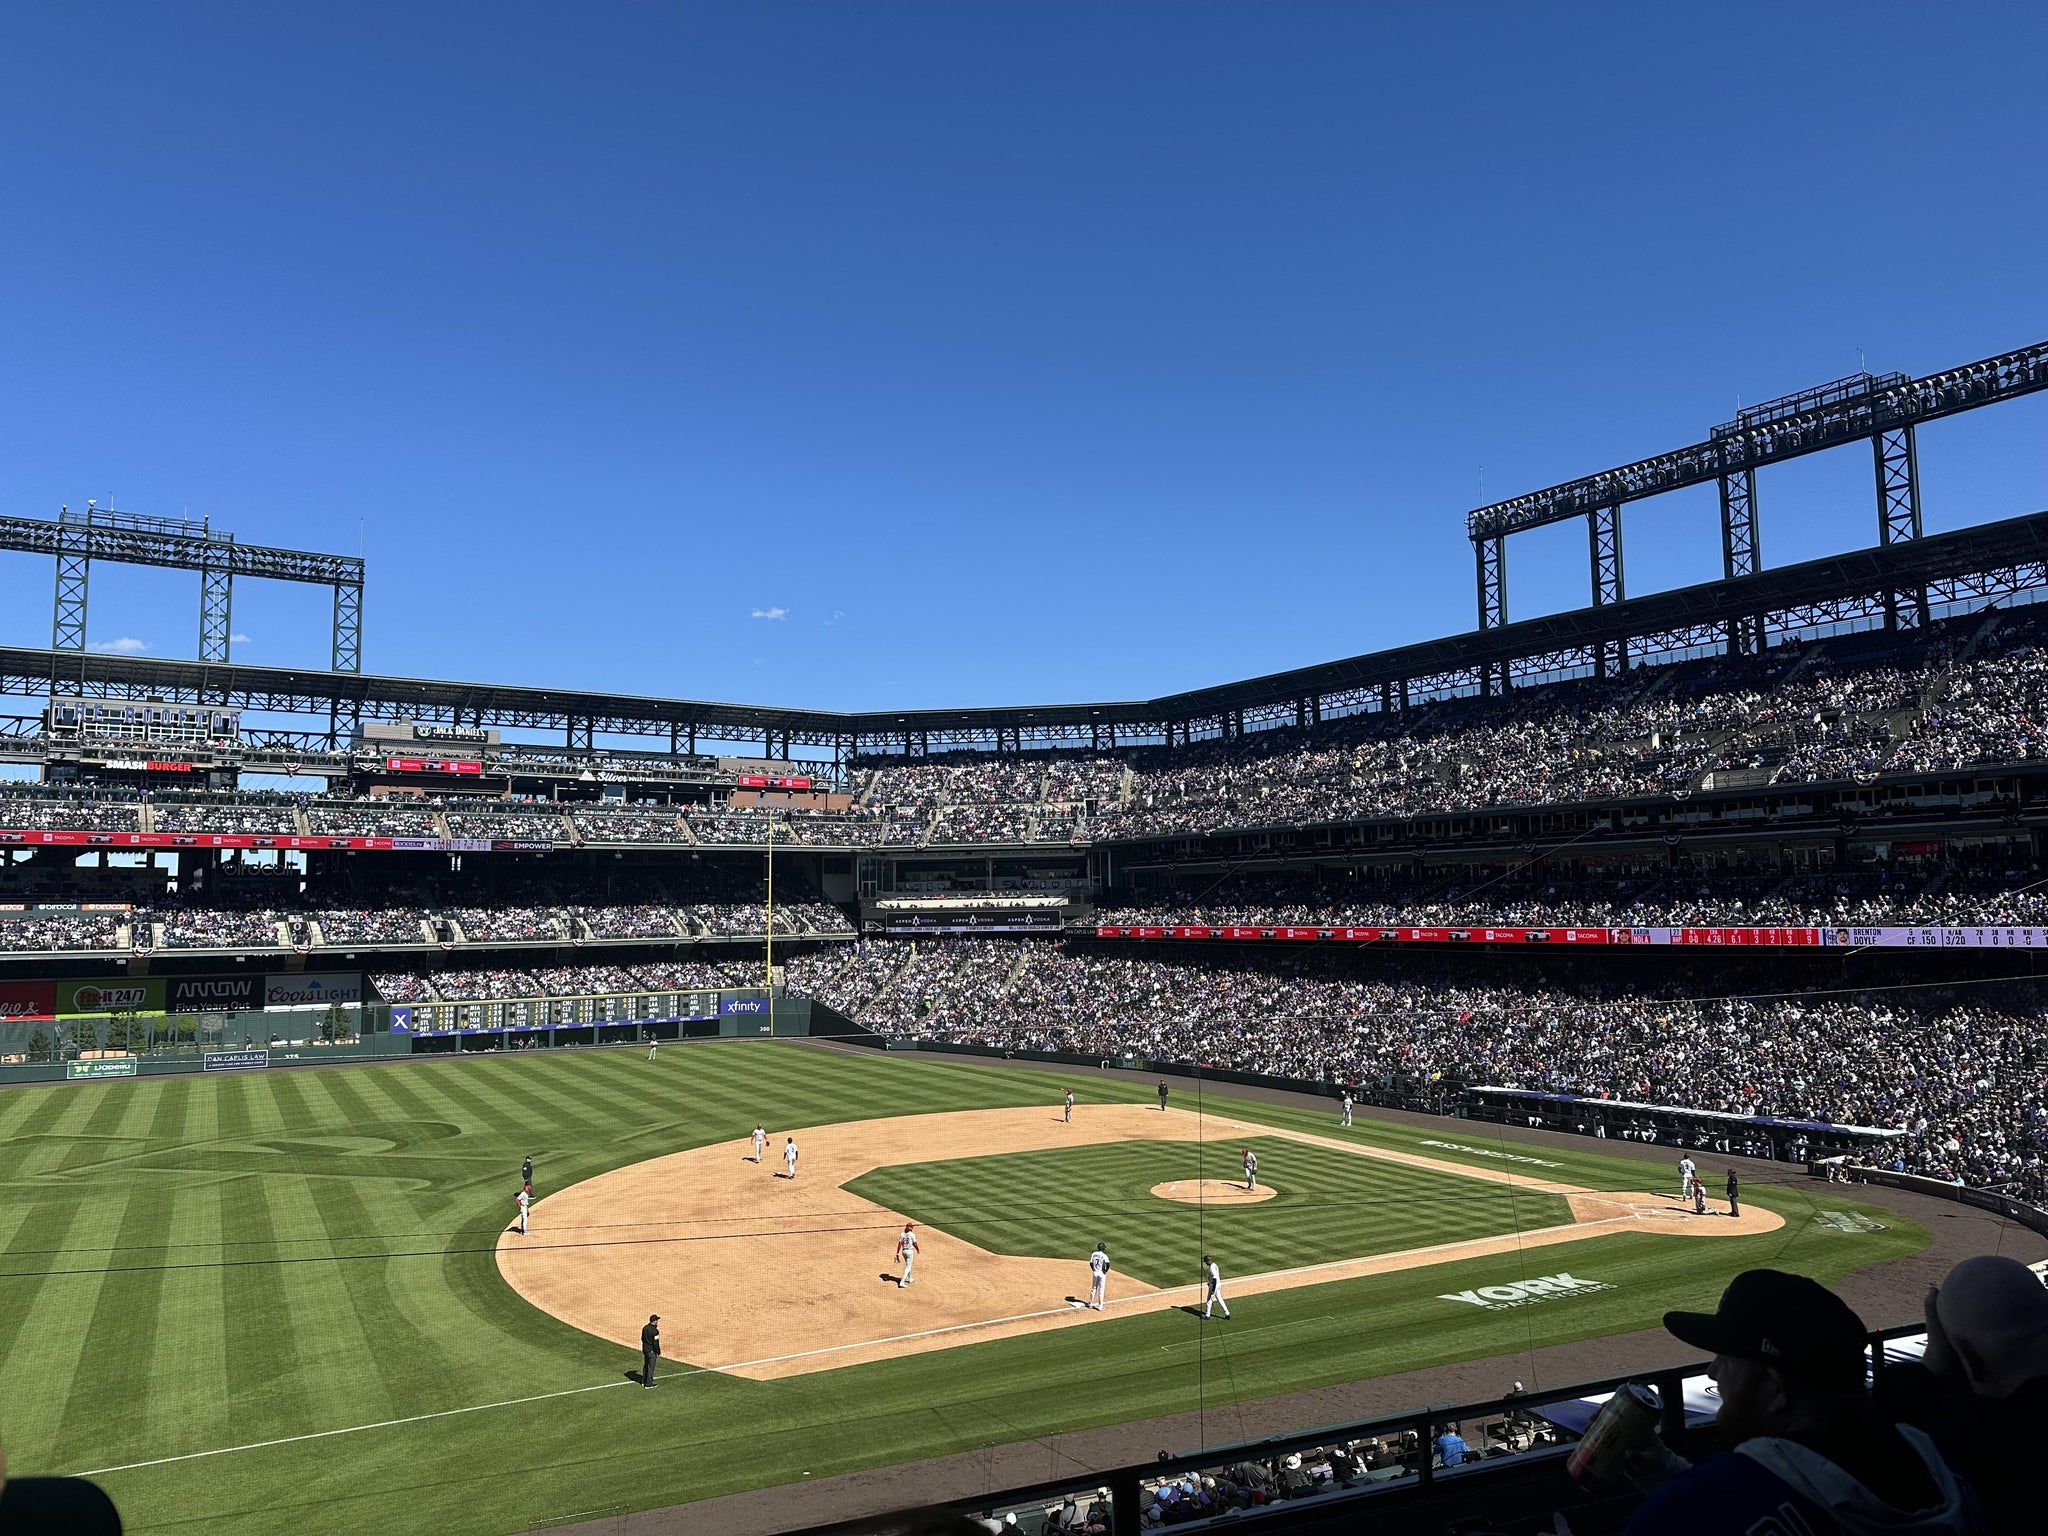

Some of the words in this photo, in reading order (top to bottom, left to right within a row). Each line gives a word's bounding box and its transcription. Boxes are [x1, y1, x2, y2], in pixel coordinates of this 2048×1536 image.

[55, 702, 104, 722] THE
[124, 706, 240, 729] ROOFTOP
[433, 725, 453, 735] JACK
[105, 759, 191, 772] SMASHBURGER
[597, 772, 626, 782] Silver
[514, 842, 552, 850] EMPOWER
[1707, 935, 1721, 944] 4.26
[1807, 936, 1812, 944] 9
[1854, 936, 1876, 945] DOYLE
[1907, 937, 1915, 945] CF
[1920, 936, 1936, 945] .150
[1946, 936, 1965, 945] 3/20
[1979, 936, 1982, 945] 1
[1993, 936, 1998, 945] 0
[2009, 936, 2014, 945] 0
[176, 981, 252, 998] ARROW
[268, 986, 315, 1003] Coors
[316, 988, 359, 1000] LIGHT
[79, 990, 113, 1002] Fix-it
[115, 990, 144, 1002] 24/7
[176, 1003, 198, 1012] Five
[200, 1002, 228, 1011] Years
[231, 1001, 251, 1010] Out
[728, 1001, 760, 1013] xfinity
[1435, 1272, 1603, 1306] YORK
[1486, 1297, 1546, 1311] SPACE
[1546, 1283, 1618, 1300] SYSTEMS
